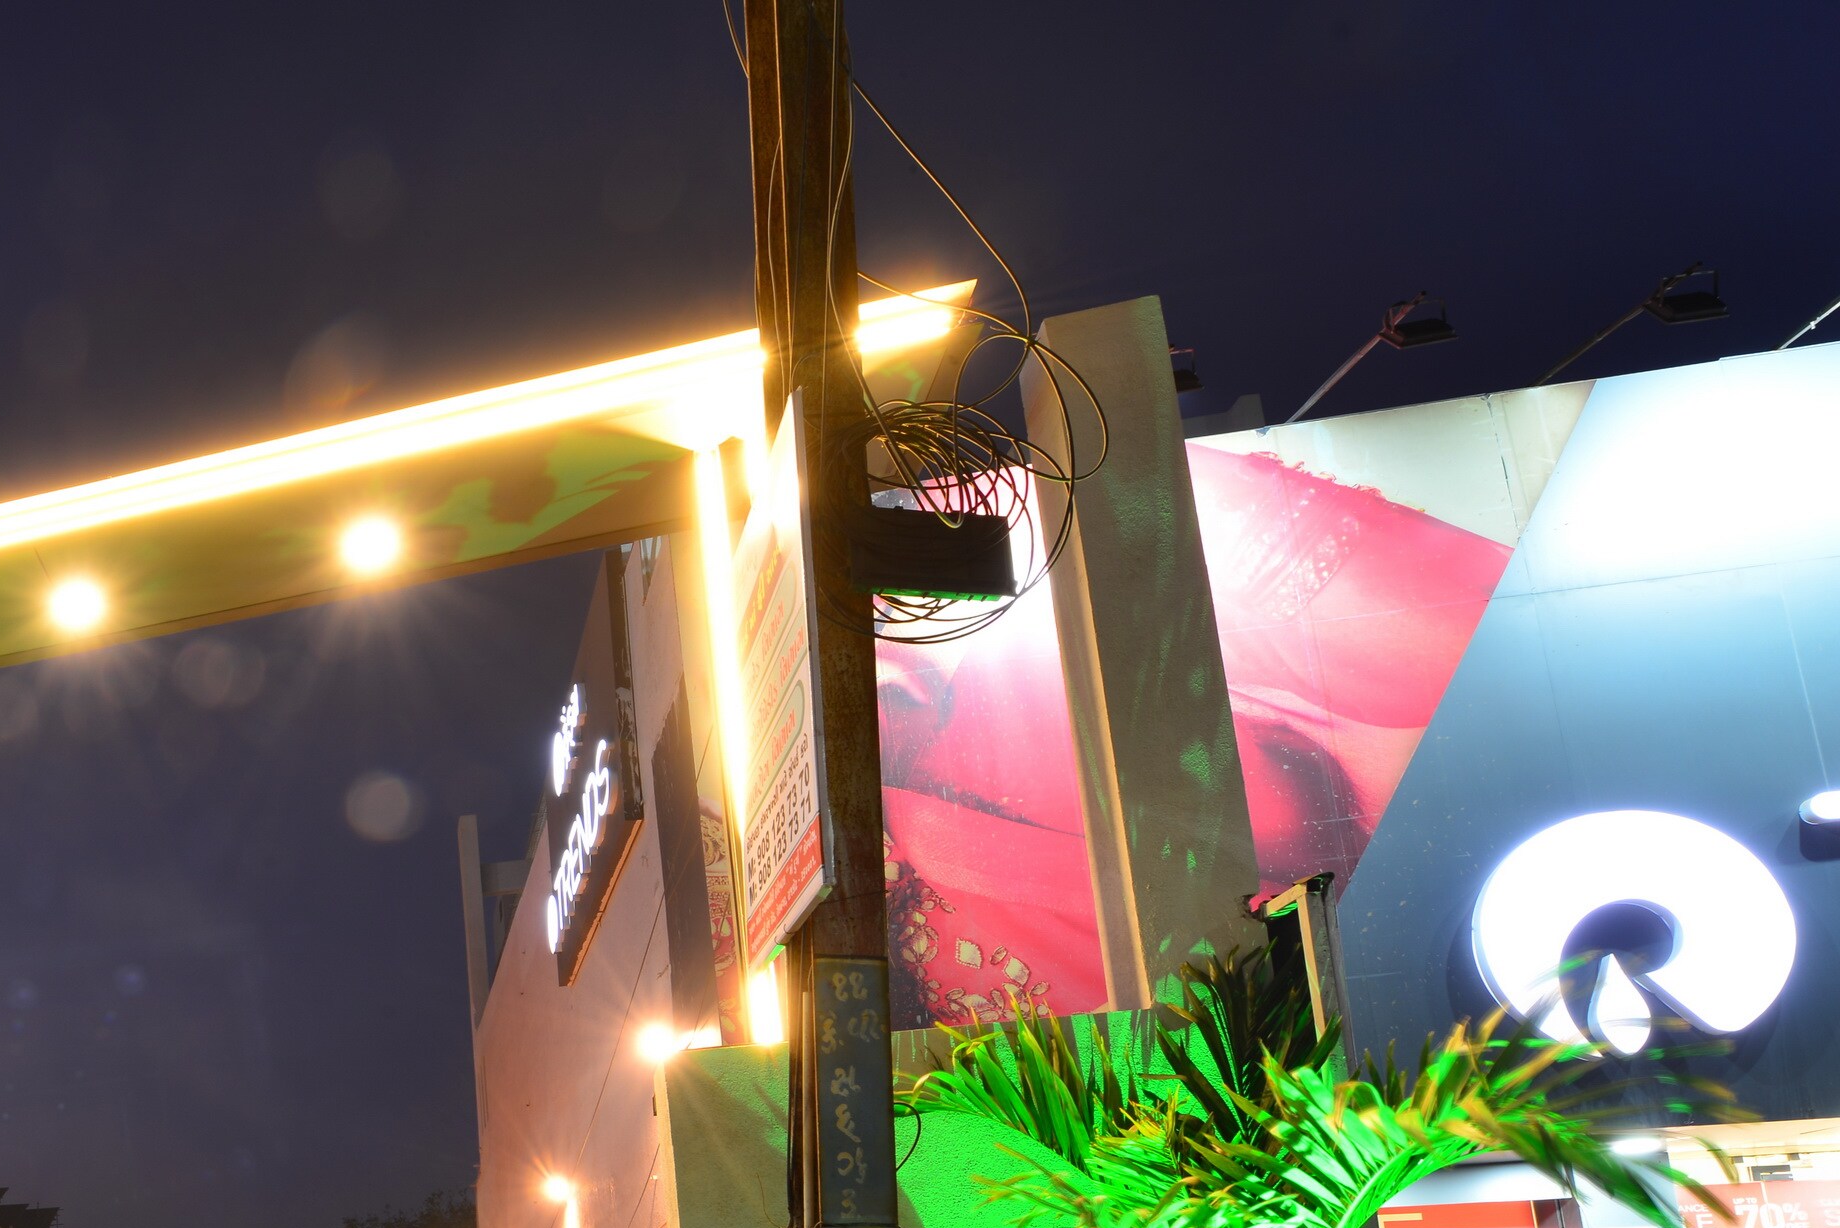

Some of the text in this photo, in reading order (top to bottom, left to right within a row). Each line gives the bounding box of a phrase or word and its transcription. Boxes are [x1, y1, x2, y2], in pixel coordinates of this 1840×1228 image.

[554, 739, 609, 930] TRENDS
[757, 830, 771, 866] 908
[771, 804, 786, 840] 123
[786, 784, 798, 815] 73
[798, 762, 810, 796] 70
[758, 856, 772, 891] 908
[773, 831, 787, 866] 123
[788, 811, 799, 842] 73
[800, 790, 812, 823] 71
